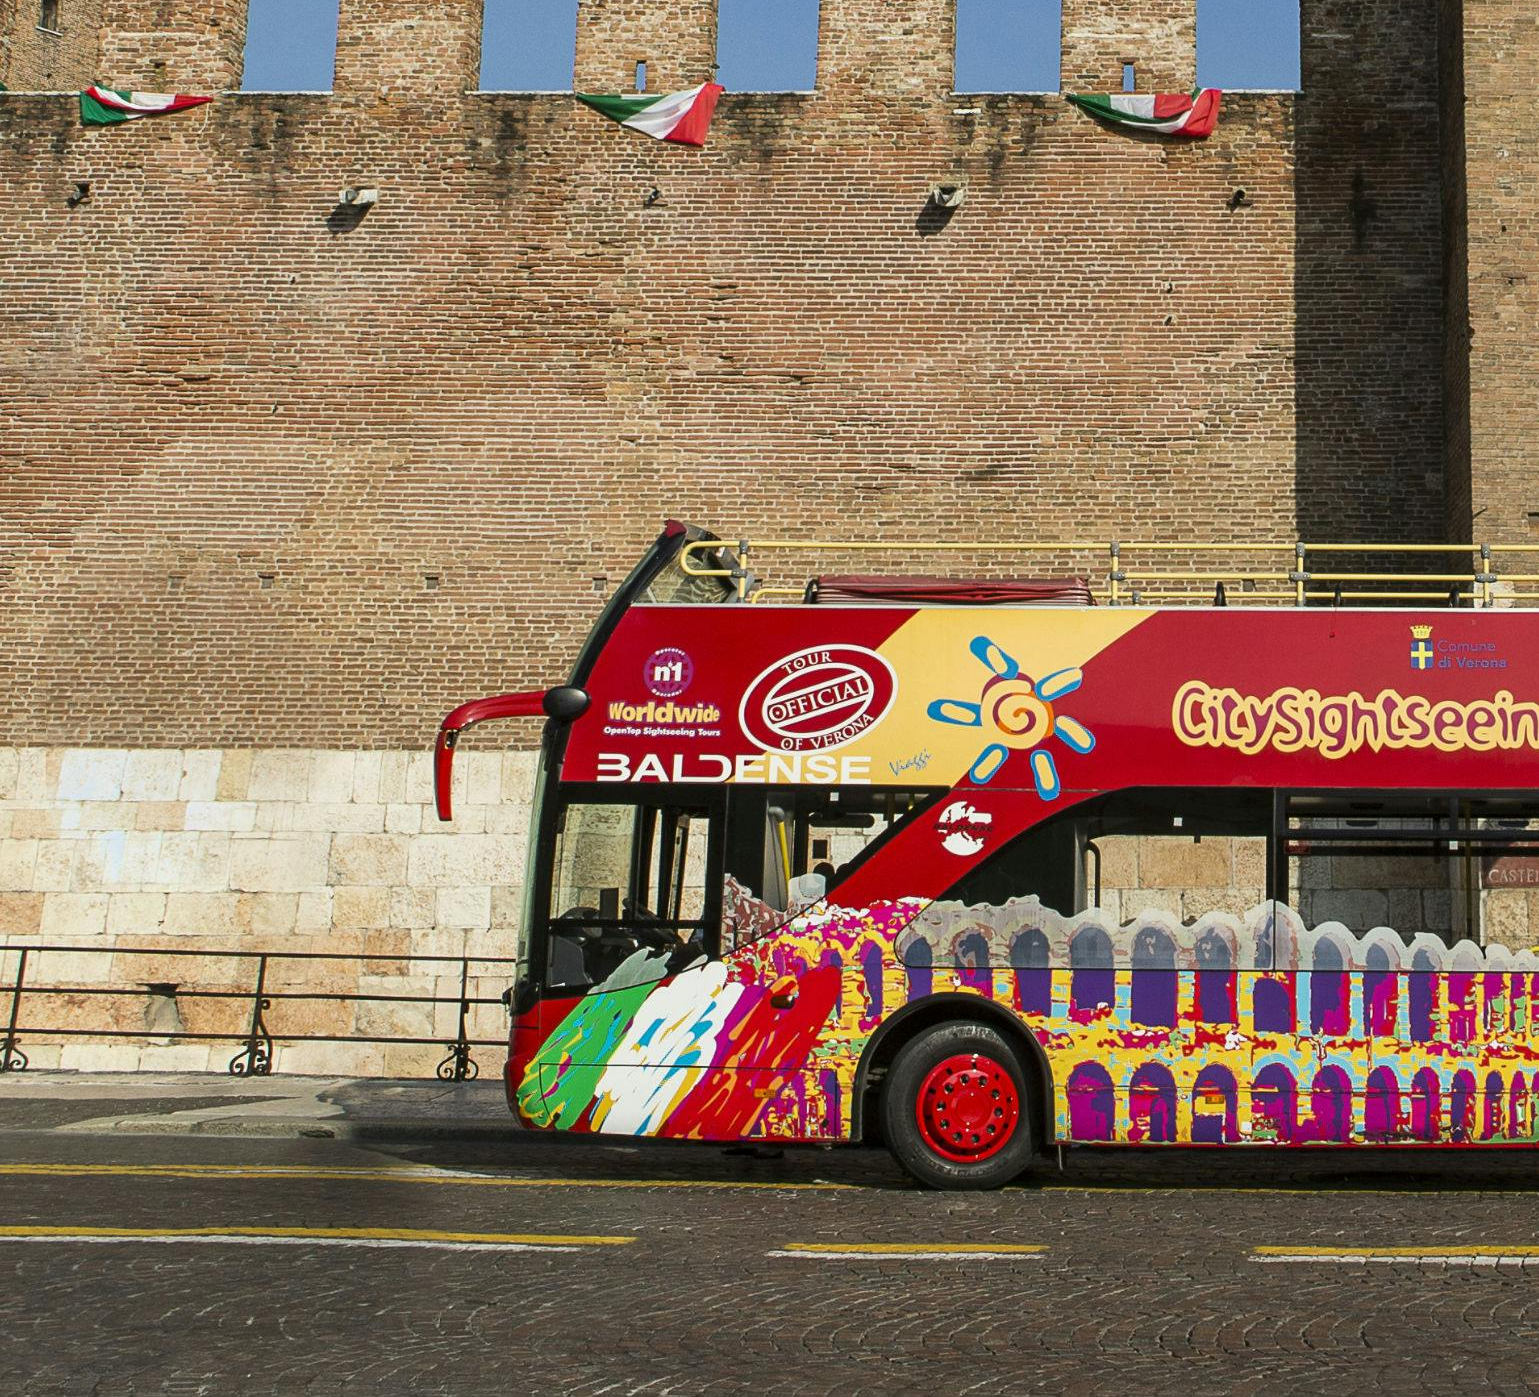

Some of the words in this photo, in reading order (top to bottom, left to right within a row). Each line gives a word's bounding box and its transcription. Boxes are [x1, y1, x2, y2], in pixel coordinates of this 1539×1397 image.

[1437, 640, 1496, 653] Comune
[781, 651, 832, 676] TOUR
[1438, 656, 1451, 669] di
[1456, 658, 1508, 669] Verona
[768, 677, 870, 722] OFFICIAL
[608, 702, 721, 723] Worldwide
[603, 726, 641, 736] OpenTop
[643, 727, 696, 738] Sightseeing
[698, 728, 721, 737] Tours
[780, 738, 803, 751] OF
[810, 713, 875, 749] VERONA
[596, 752, 872, 784] BALDENSE
[888, 747, 932, 776] Viaggi
